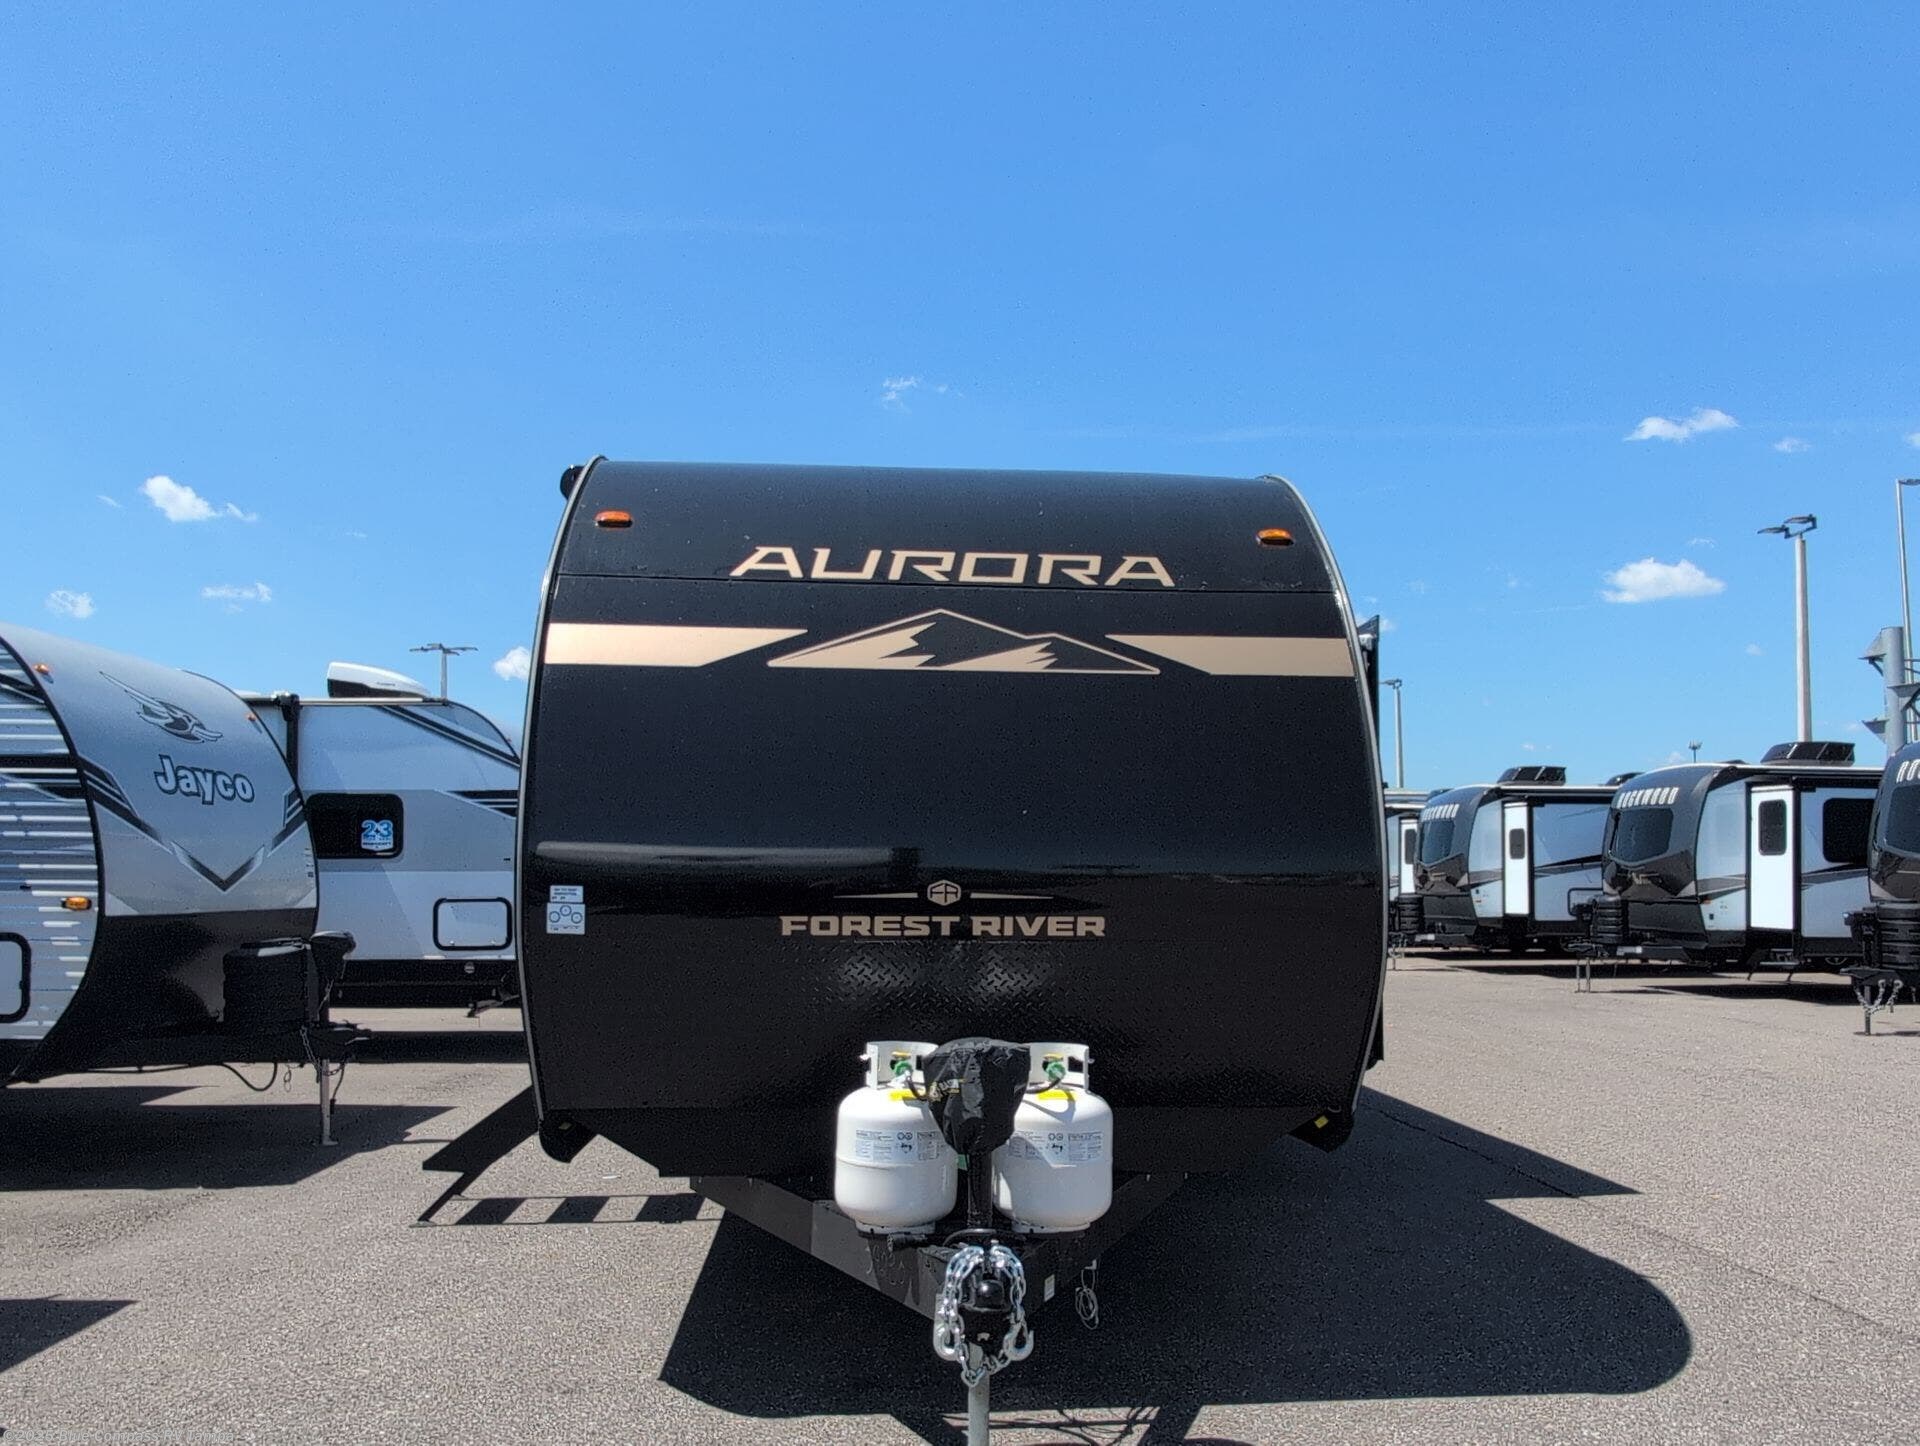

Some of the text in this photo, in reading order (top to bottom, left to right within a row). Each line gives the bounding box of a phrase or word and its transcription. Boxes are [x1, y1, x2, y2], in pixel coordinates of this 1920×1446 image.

[729, 546, 1176, 587] AURORA
[153, 753, 255, 805] Jayco
[1896, 758, 1920, 783] RO
[779, 915, 1106, 937] FOREST RIVER
